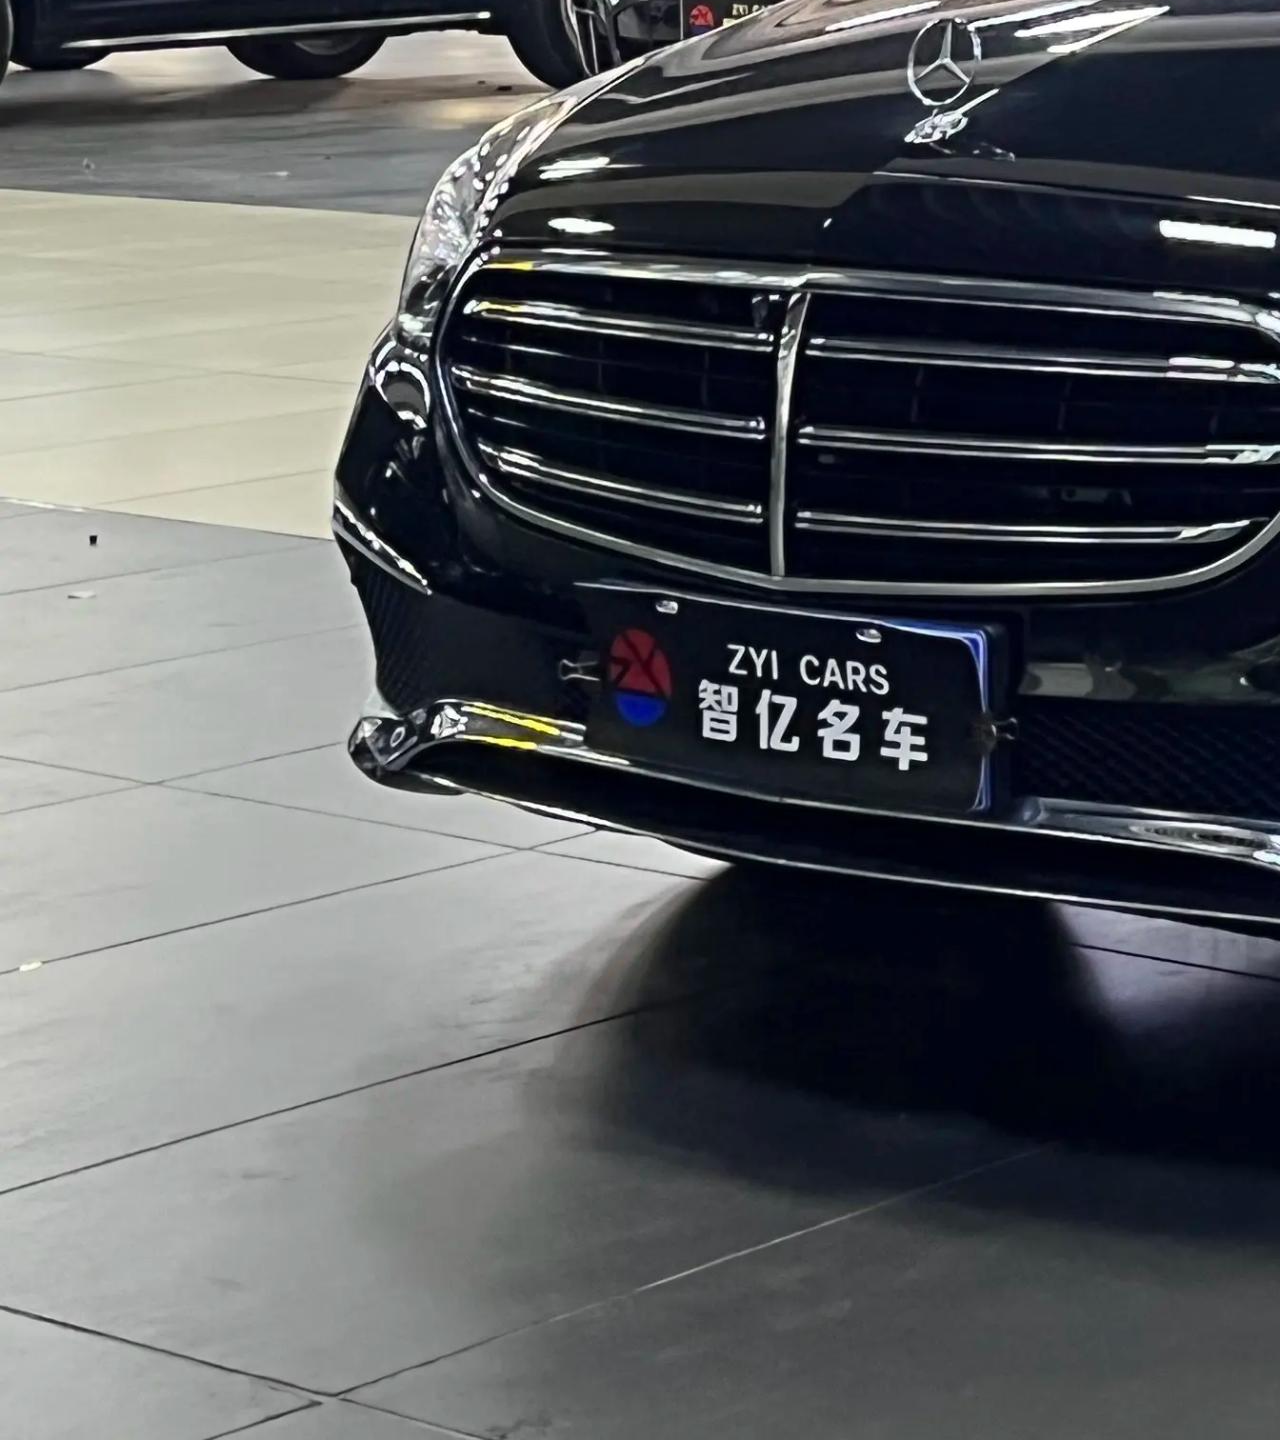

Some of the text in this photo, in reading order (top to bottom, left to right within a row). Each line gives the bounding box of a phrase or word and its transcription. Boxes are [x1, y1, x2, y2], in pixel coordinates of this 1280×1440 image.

[726, 643, 890, 696] ZYI CARS
[697, 679, 929, 772] 智亿名车
